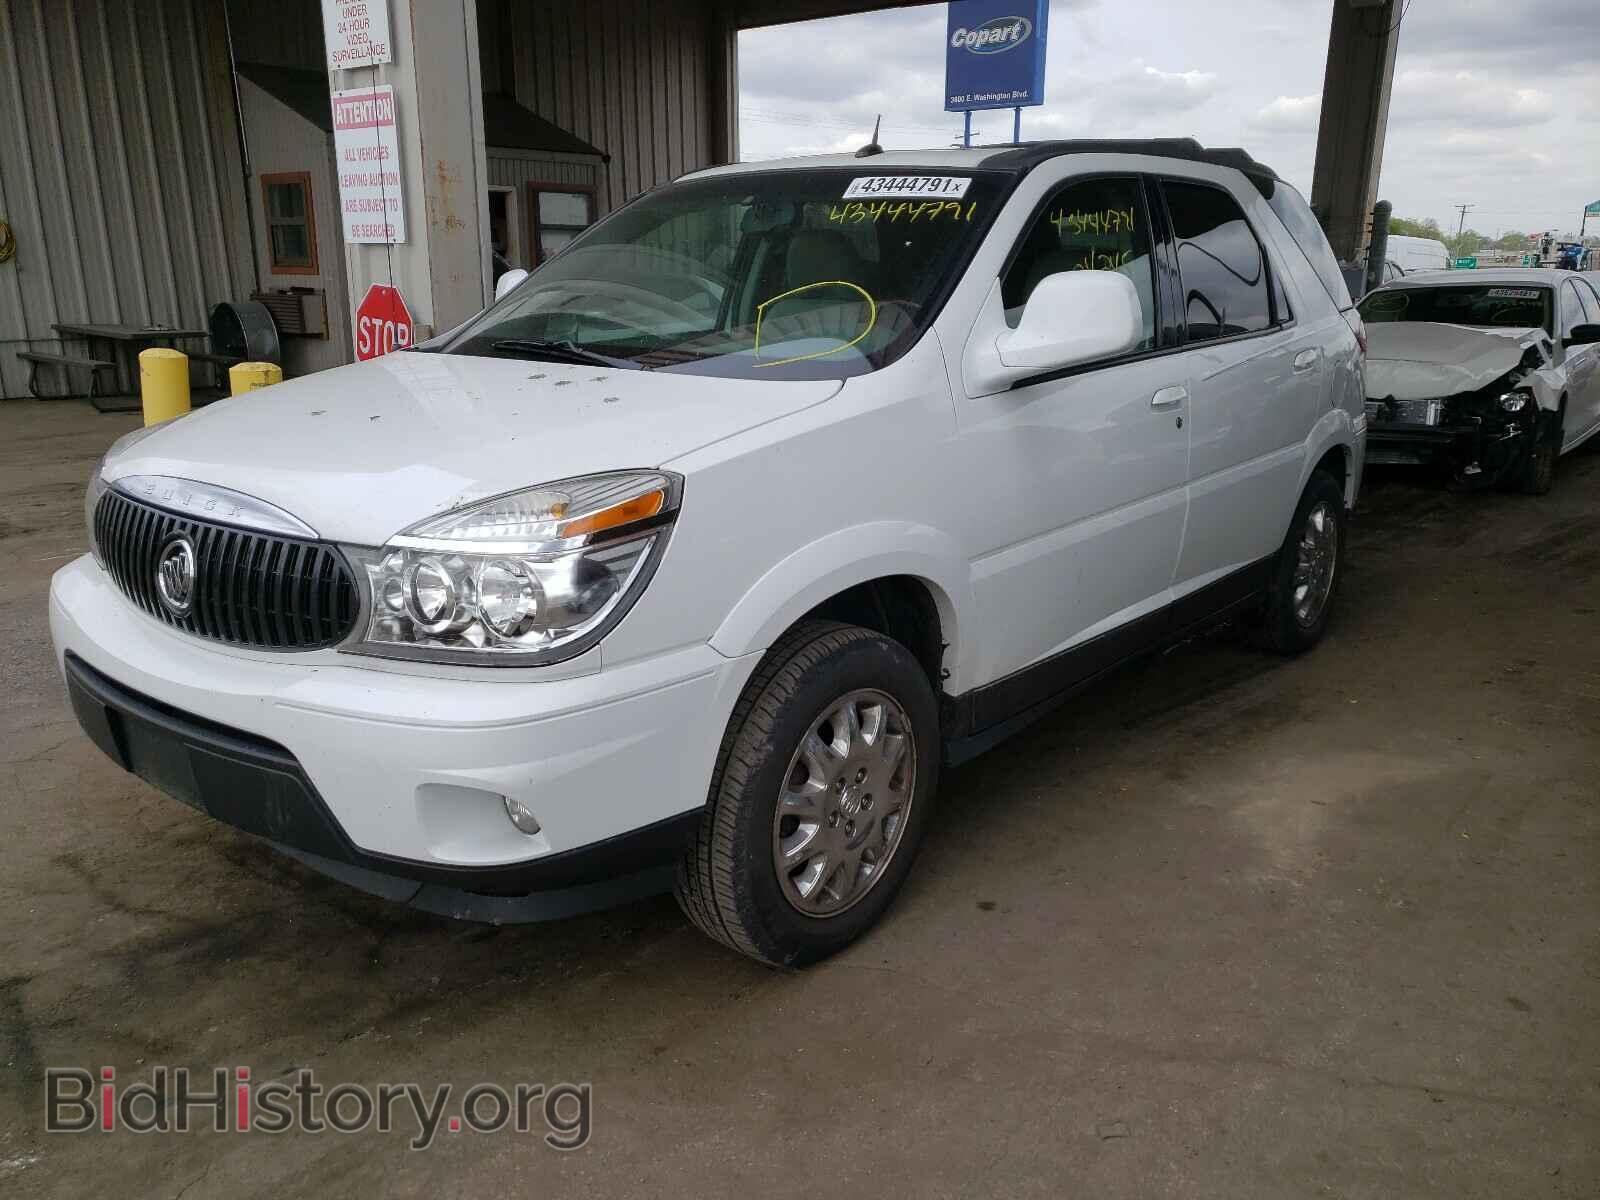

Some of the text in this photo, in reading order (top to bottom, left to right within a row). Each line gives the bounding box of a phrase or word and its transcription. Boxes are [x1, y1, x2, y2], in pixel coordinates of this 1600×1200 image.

[343, 4, 368, 18] UNDER
[337, 18, 370, 33] 24 HOUR
[347, 32, 368, 45] VIDEO
[951, 20, 1022, 48] Copart
[333, 43, 386, 62] SURVEILLANCE
[973, 92, 1011, 102] Washington
[1012, 90, 1029, 98] Blvd.
[336, 98, 392, 124] ATTENTION
[345, 145, 389, 161] ALL VEHICLES
[341, 171, 398, 188] LEAVING AUCTION
[861, 177, 952, 193] 43444791
[345, 198, 398, 213] ARE SUBJECT TO
[829, 201, 977, 224] 43444791
[351, 223, 396, 238] BE SEARCHED
[359, 315, 409, 355] STOP
[143, 480, 244, 518] BUICK
